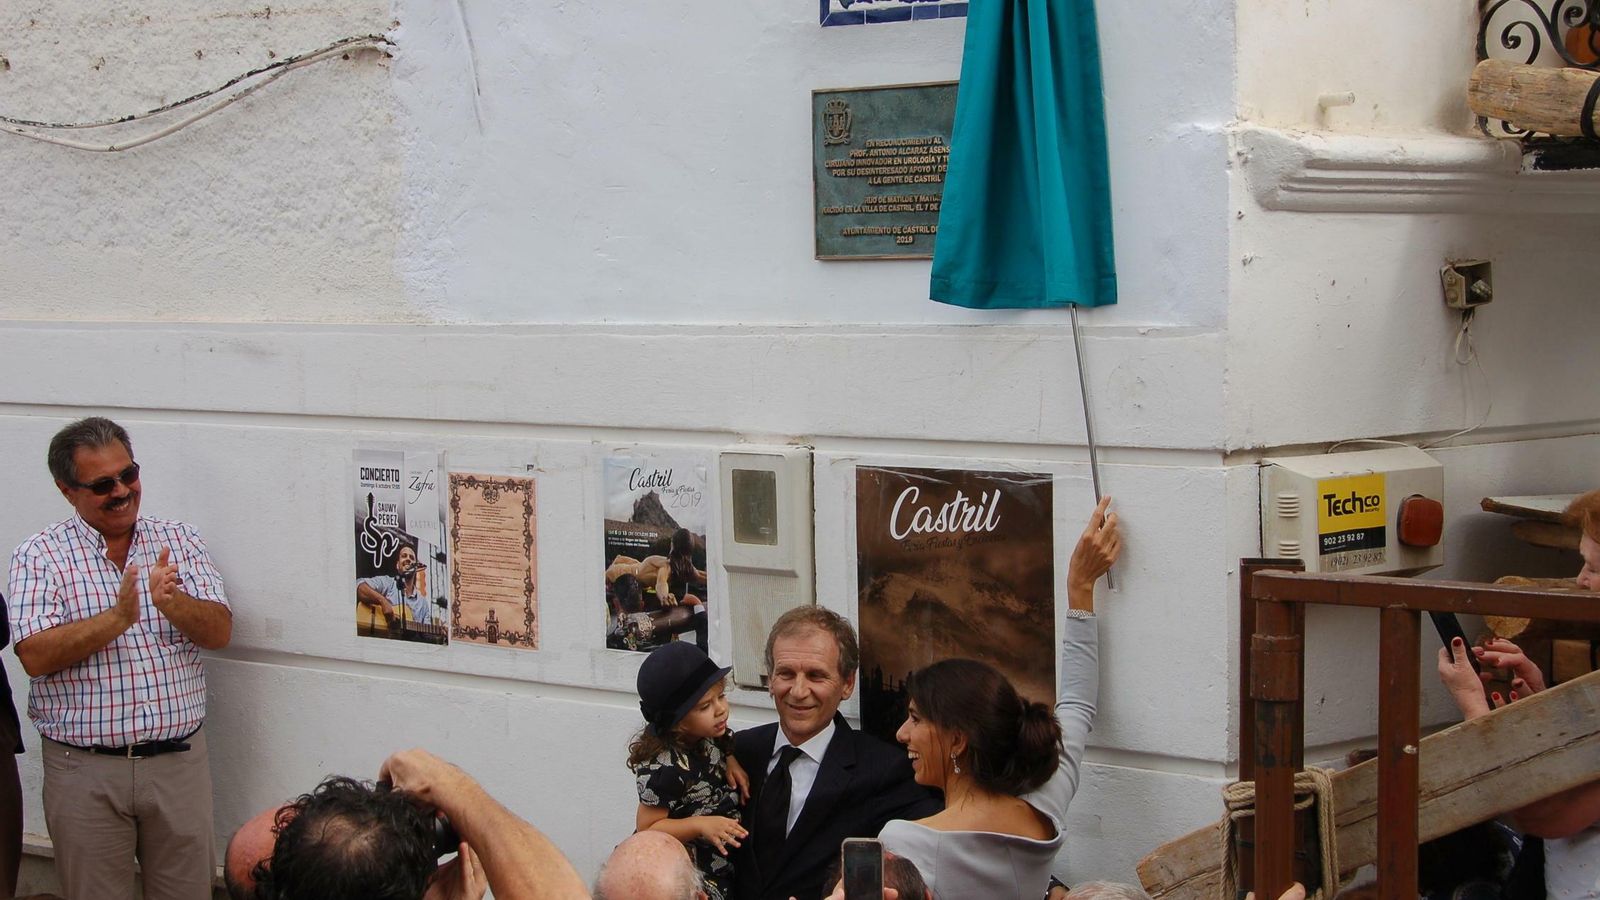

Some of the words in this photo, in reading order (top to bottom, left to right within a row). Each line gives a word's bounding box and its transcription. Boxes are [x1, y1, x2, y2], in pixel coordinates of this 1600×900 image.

[865, 140, 875, 148] EN
[876, 138, 932, 147] RECONOCIMIENTO
[933, 137, 942, 145] AL
[849, 149, 869, 158] PROF.
[869, 148, 897, 157] ANTONIO
[898, 147, 928, 156] ALCARAZ
[824, 160, 855, 168] CIRUJANO
[856, 158, 893, 167] INNOVADOR
[893, 157, 903, 165] EN
[903, 155, 936, 165] UROLOGÍA
[832, 169, 846, 177] POR
[846, 168, 856, 176] SU
[856, 167, 908, 176] DESINTERESADO
[908, 165, 931, 174] APOYO
[882, 176, 904, 184] GENTE
[904, 175, 913, 183] DE
[914, 174, 942, 183] CASTRIL
[878, 196, 887, 204] DE
[887, 195, 914, 203] MATILDE
[853, 205, 862, 213] LA
[862, 204, 879, 213] VILLA
[879, 204, 888, 212] DE
[915, 203, 924, 211] EL
[929, 203, 938, 211] DE
[842, 226, 891, 235] AYUNTAMIENTO
[892, 226, 902, 234] DE
[902, 225, 930, 234] CASTRIL
[360, 467, 400, 482] CONCIERTO
[629, 467, 673, 491] Castril
[408, 469, 436, 505] Zafra
[671, 491, 702, 508] 2019
[377, 502, 397, 513] SAUWY
[889, 486, 1001, 541] Castril
[378, 513, 398, 526] PEREZ
[1323, 536, 1337, 546] 902
[1337, 534, 1346, 543] 23
[1346, 533, 1356, 542] 92
[1356, 532, 1365, 541] 87
